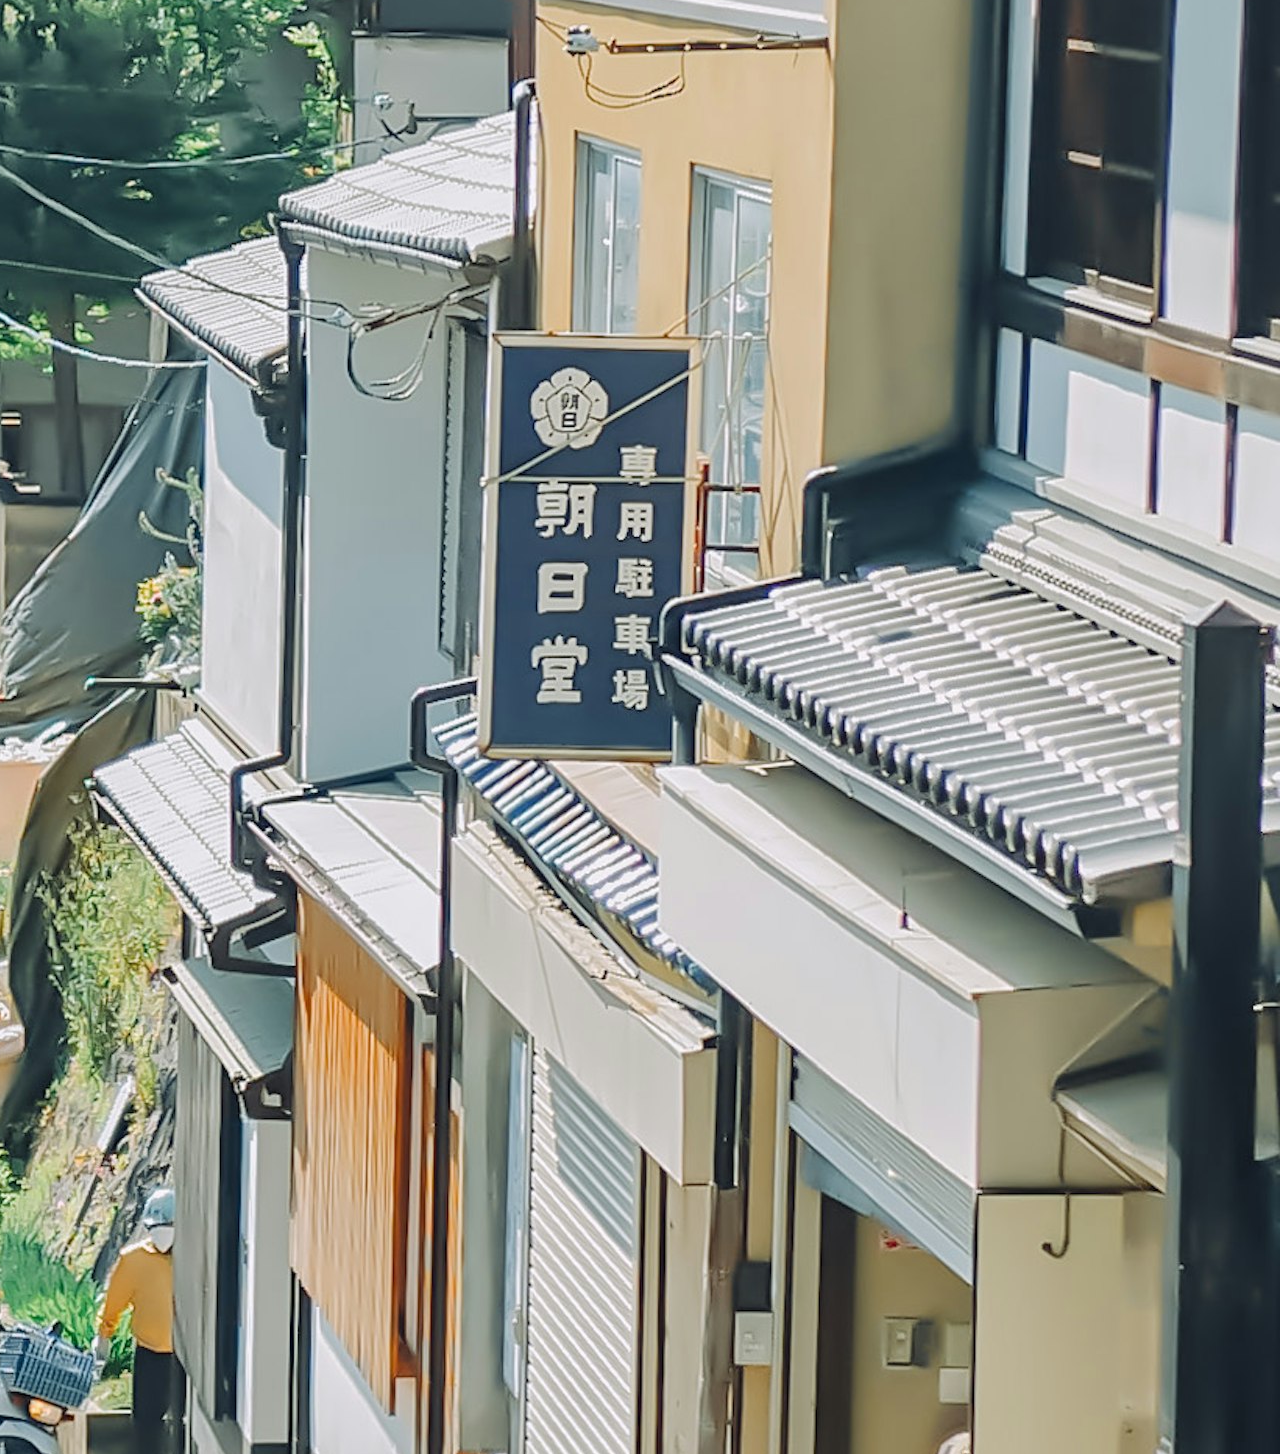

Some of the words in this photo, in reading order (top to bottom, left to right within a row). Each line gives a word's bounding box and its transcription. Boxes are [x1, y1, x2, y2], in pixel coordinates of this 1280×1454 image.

[531, 480, 597, 704] 朝日堂
[612, 445, 658, 710] 専用駐車場
